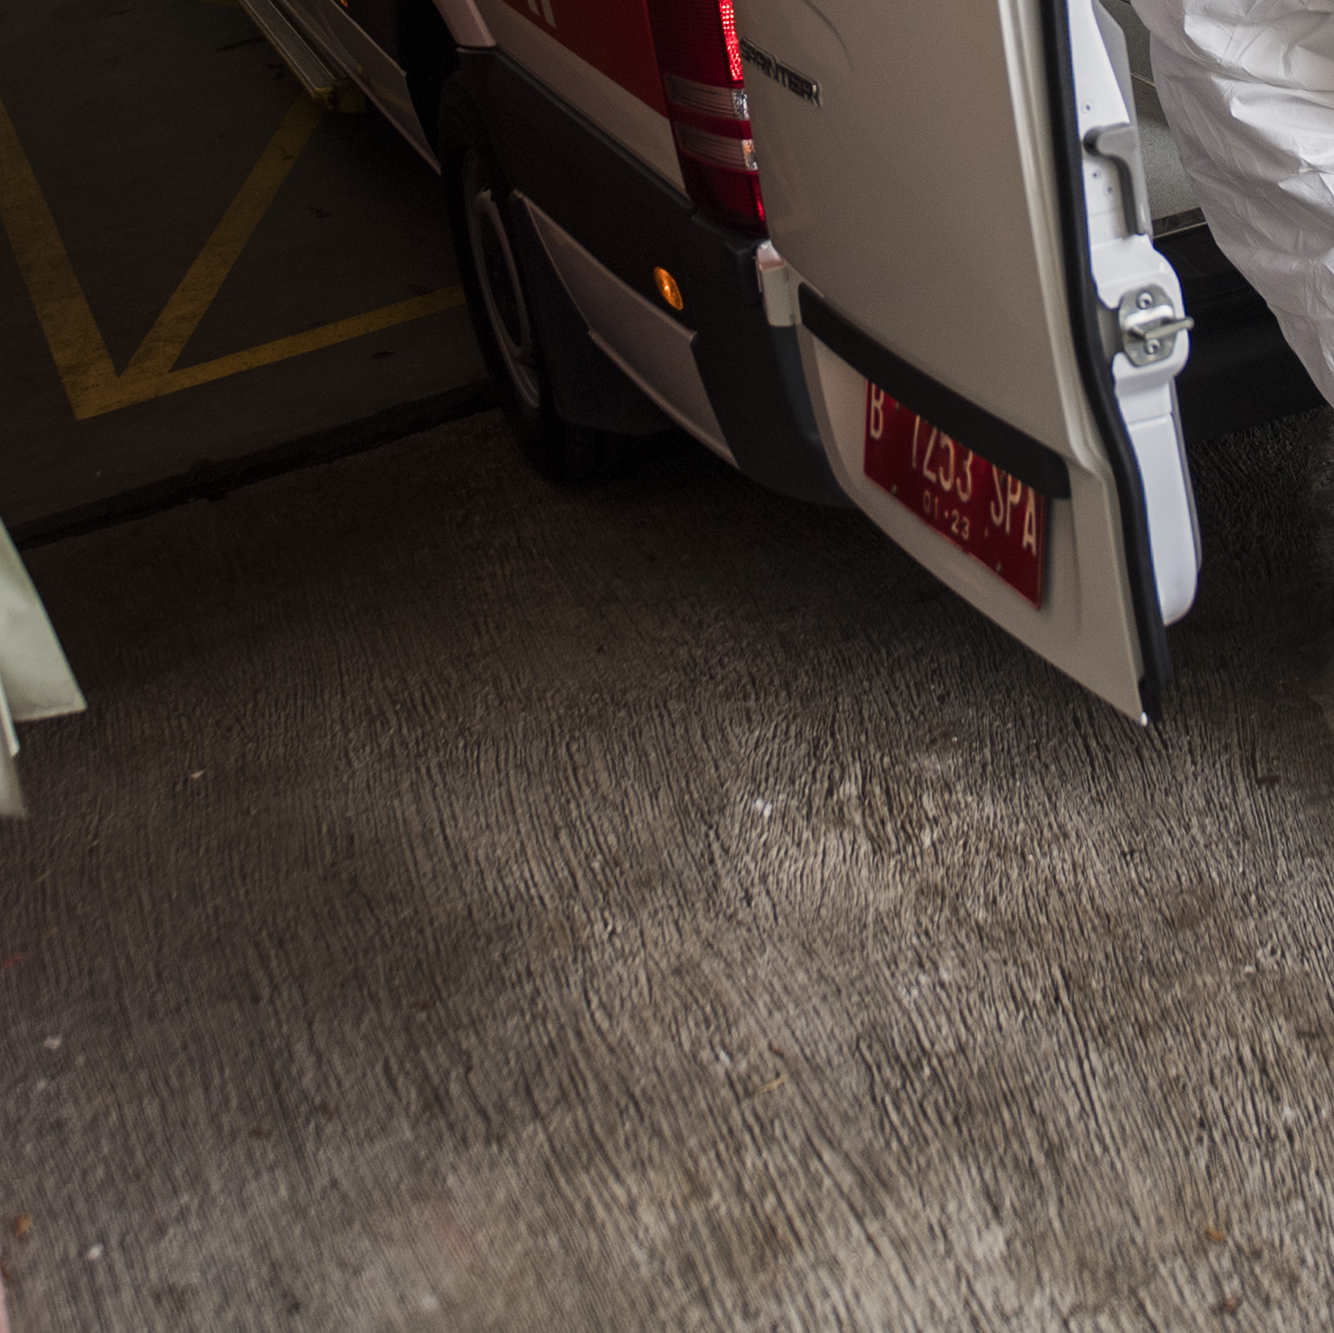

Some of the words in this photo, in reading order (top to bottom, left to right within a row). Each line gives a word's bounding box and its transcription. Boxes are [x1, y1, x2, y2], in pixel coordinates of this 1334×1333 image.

[740, 37, 822, 108] SPRINTER
[869, 382, 885, 441] B
[989, 464, 1038, 557] SPA
